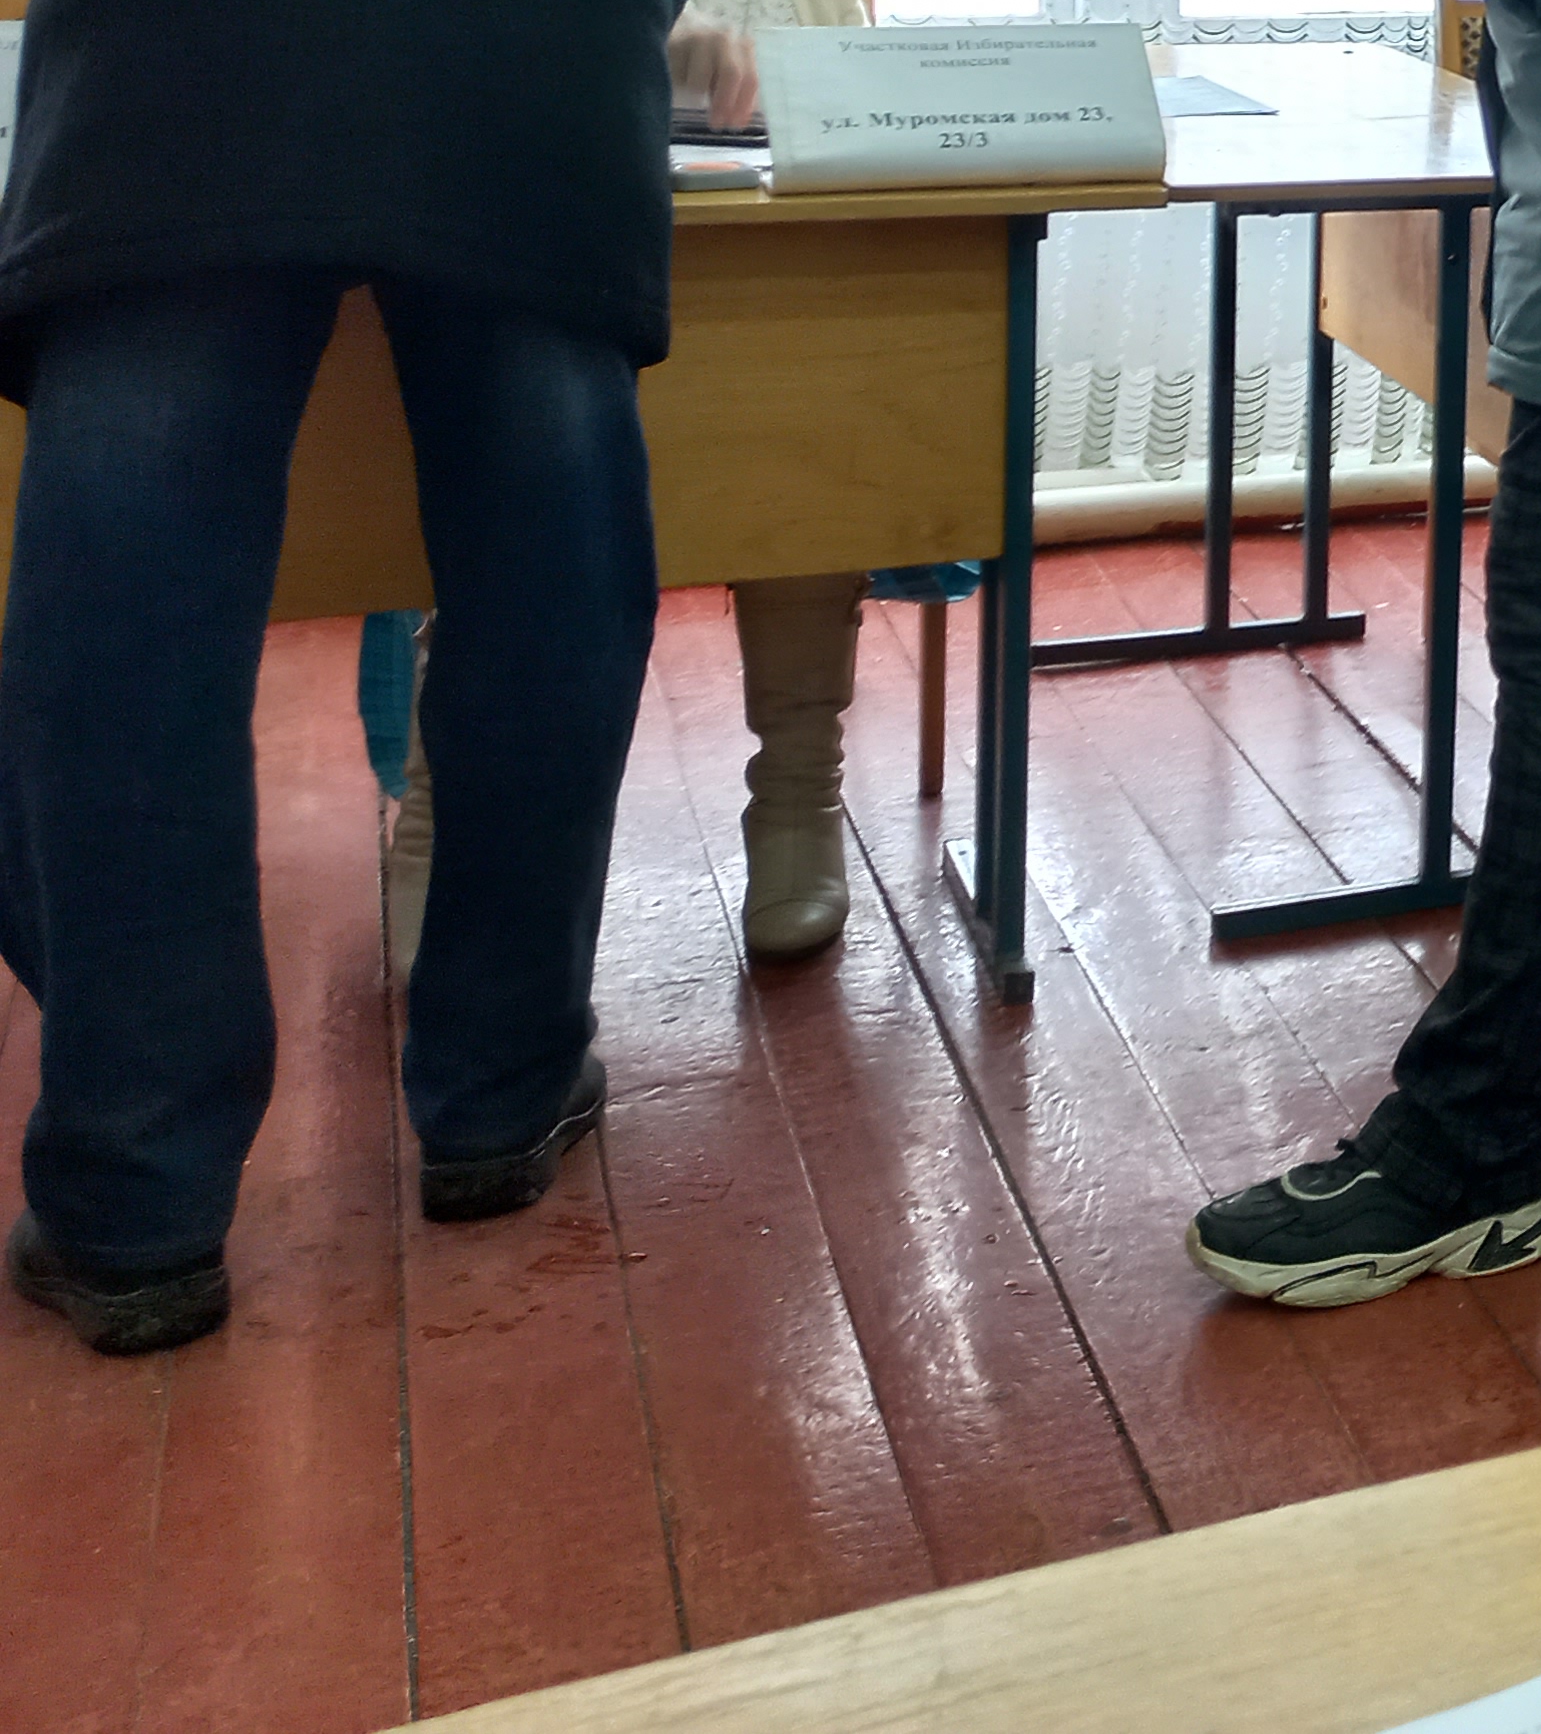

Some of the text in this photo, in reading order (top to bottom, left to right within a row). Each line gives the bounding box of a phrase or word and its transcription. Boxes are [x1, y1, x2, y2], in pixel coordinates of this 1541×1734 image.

[838, 40, 949, 53] Участковая
[920, 57, 1011, 68] комиссия
[868, 111, 1016, 131] Муромская
[1024, 112, 1071, 125] дом
[1077, 106, 1113, 123] 23,
[939, 132, 989, 148] 23/3
